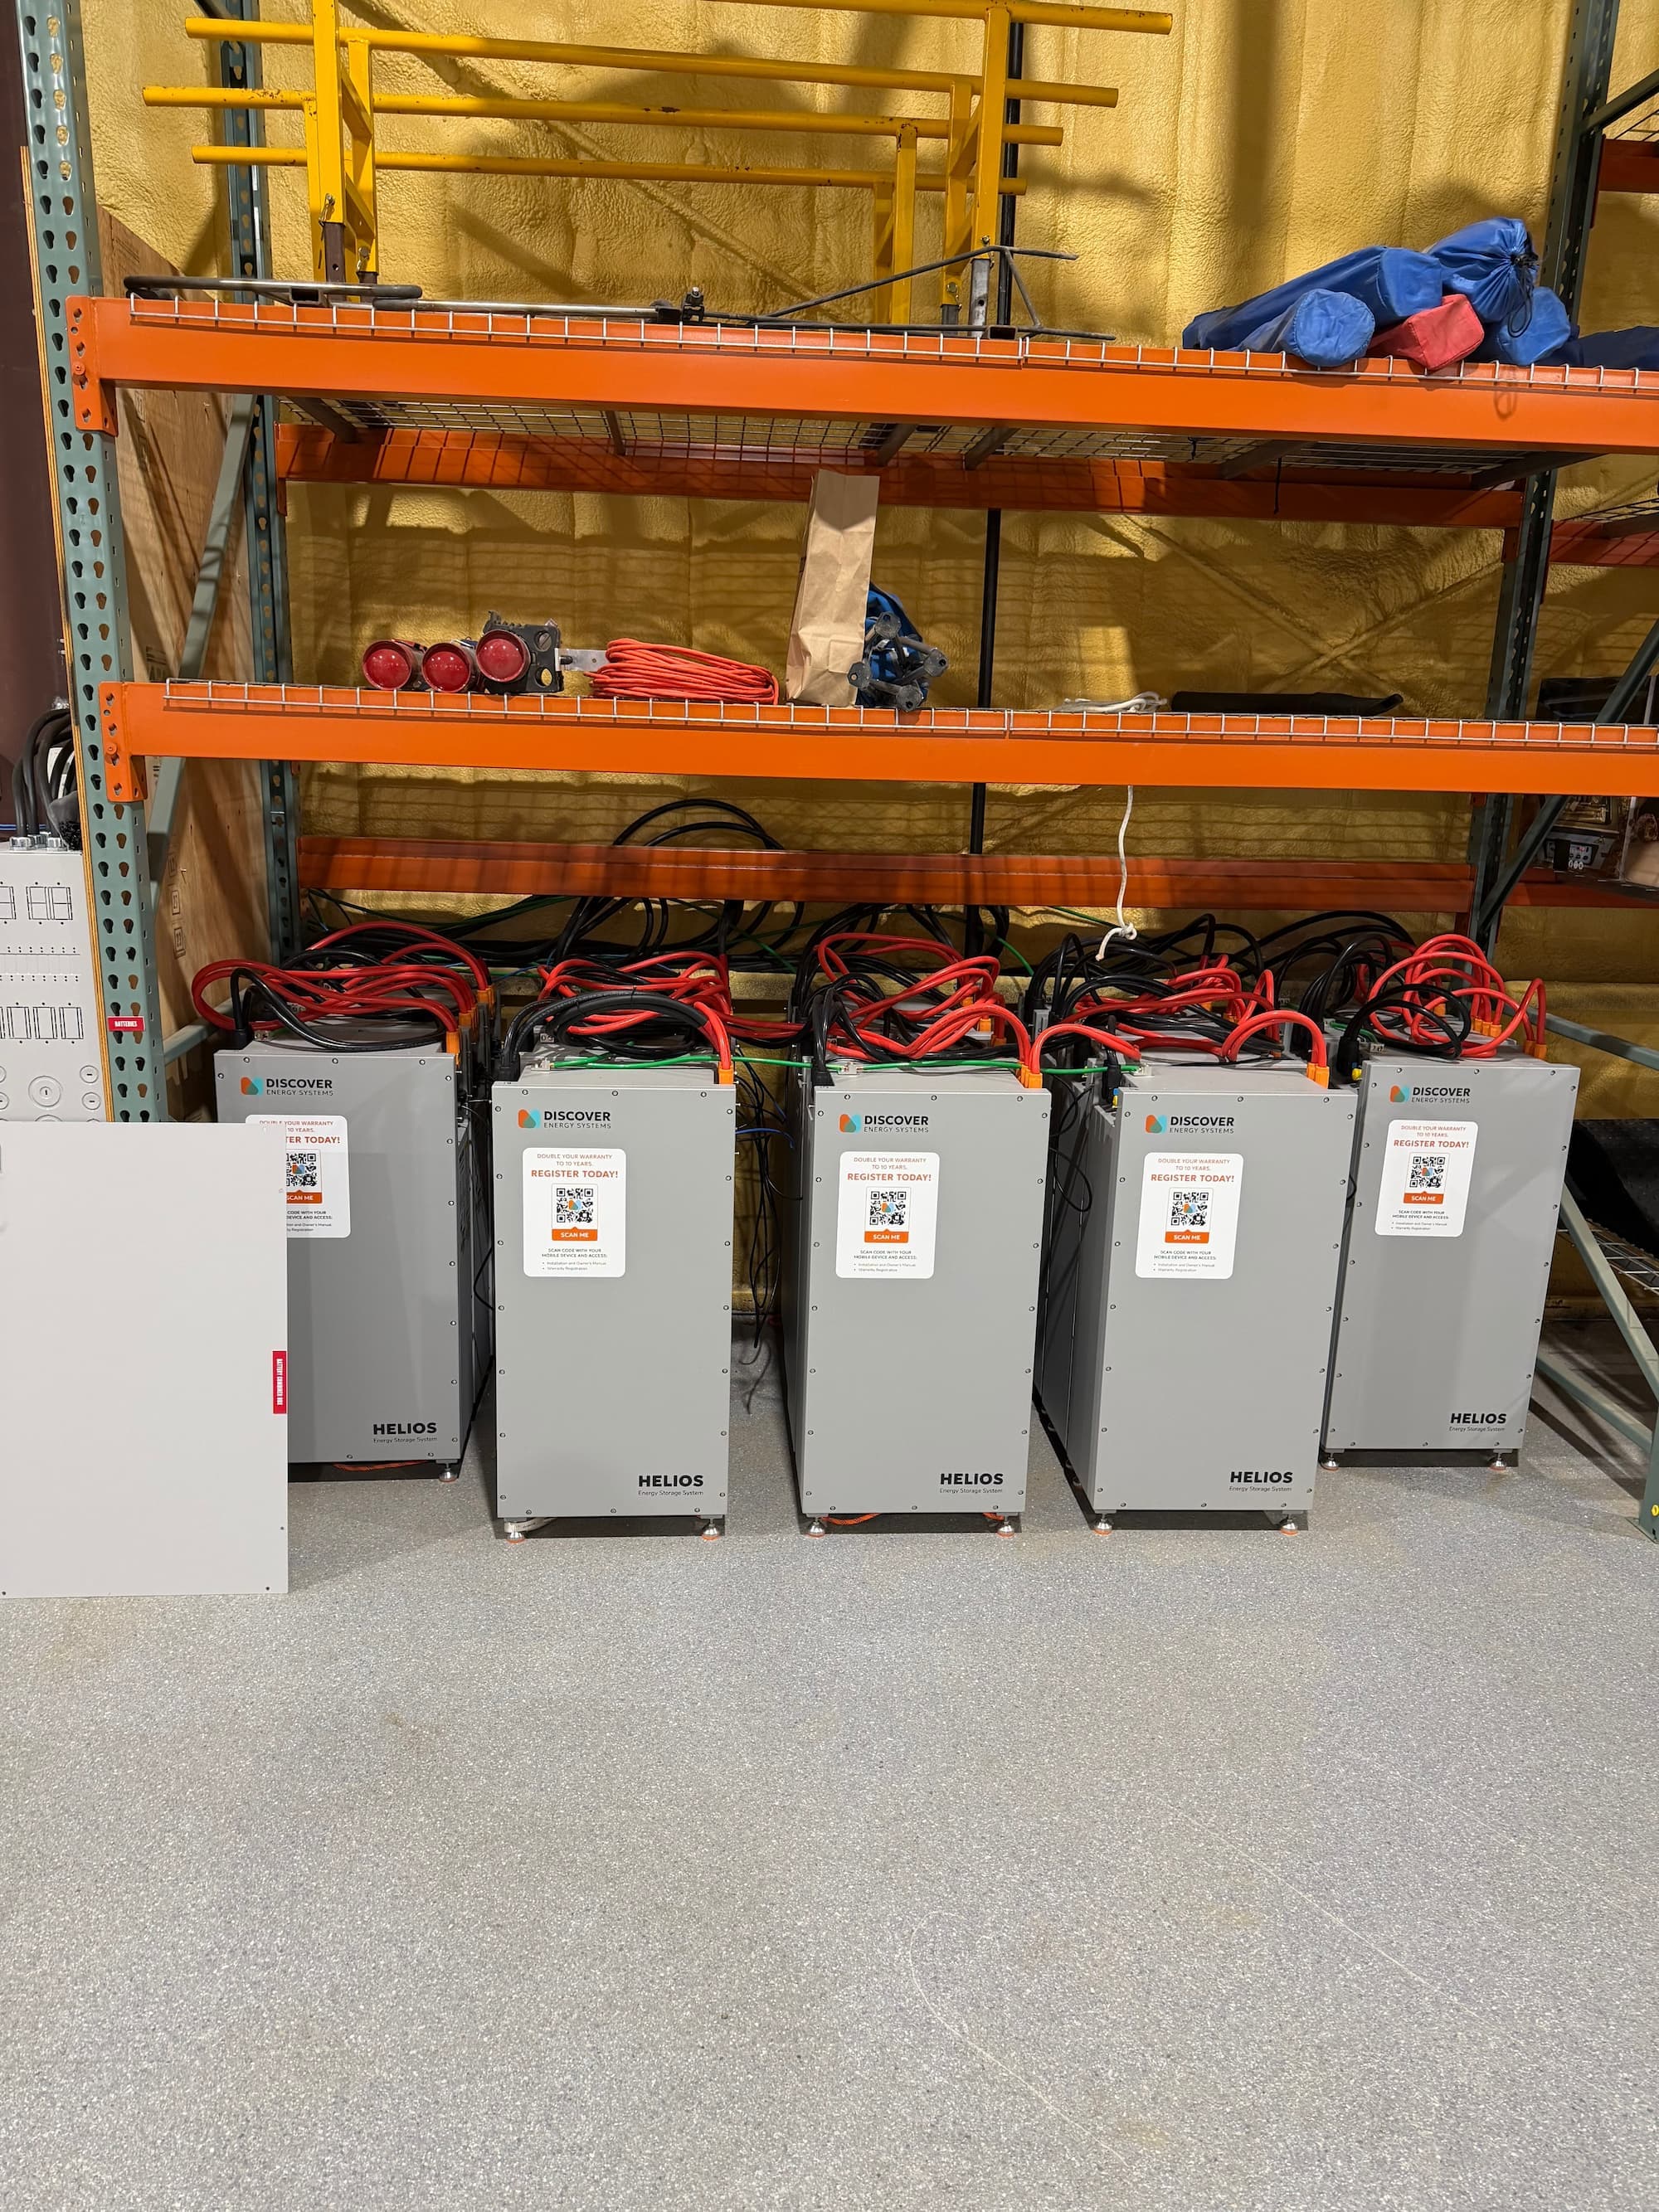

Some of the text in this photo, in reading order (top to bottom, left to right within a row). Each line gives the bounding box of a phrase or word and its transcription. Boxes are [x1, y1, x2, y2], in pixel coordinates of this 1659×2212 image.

[266, 1078, 333, 1088] DISCOVER
[1413, 1087, 1471, 1096] DISCOVER
[544, 1111, 611, 1121] DISCOVER
[864, 1116, 928, 1125] DISCOVER
[1170, 1116, 1234, 1126] DISCOVER
[848, 1173, 932, 1181] REGISTER TODAY!
[1450, 1413, 1506, 1424] HELIOS
[373, 1422, 437, 1435] HELIOS
[639, 1475, 703, 1487] HELIOS
[941, 1473, 1004, 1485] HELIOS
[1230, 1471, 1293, 1483] HELIOS
